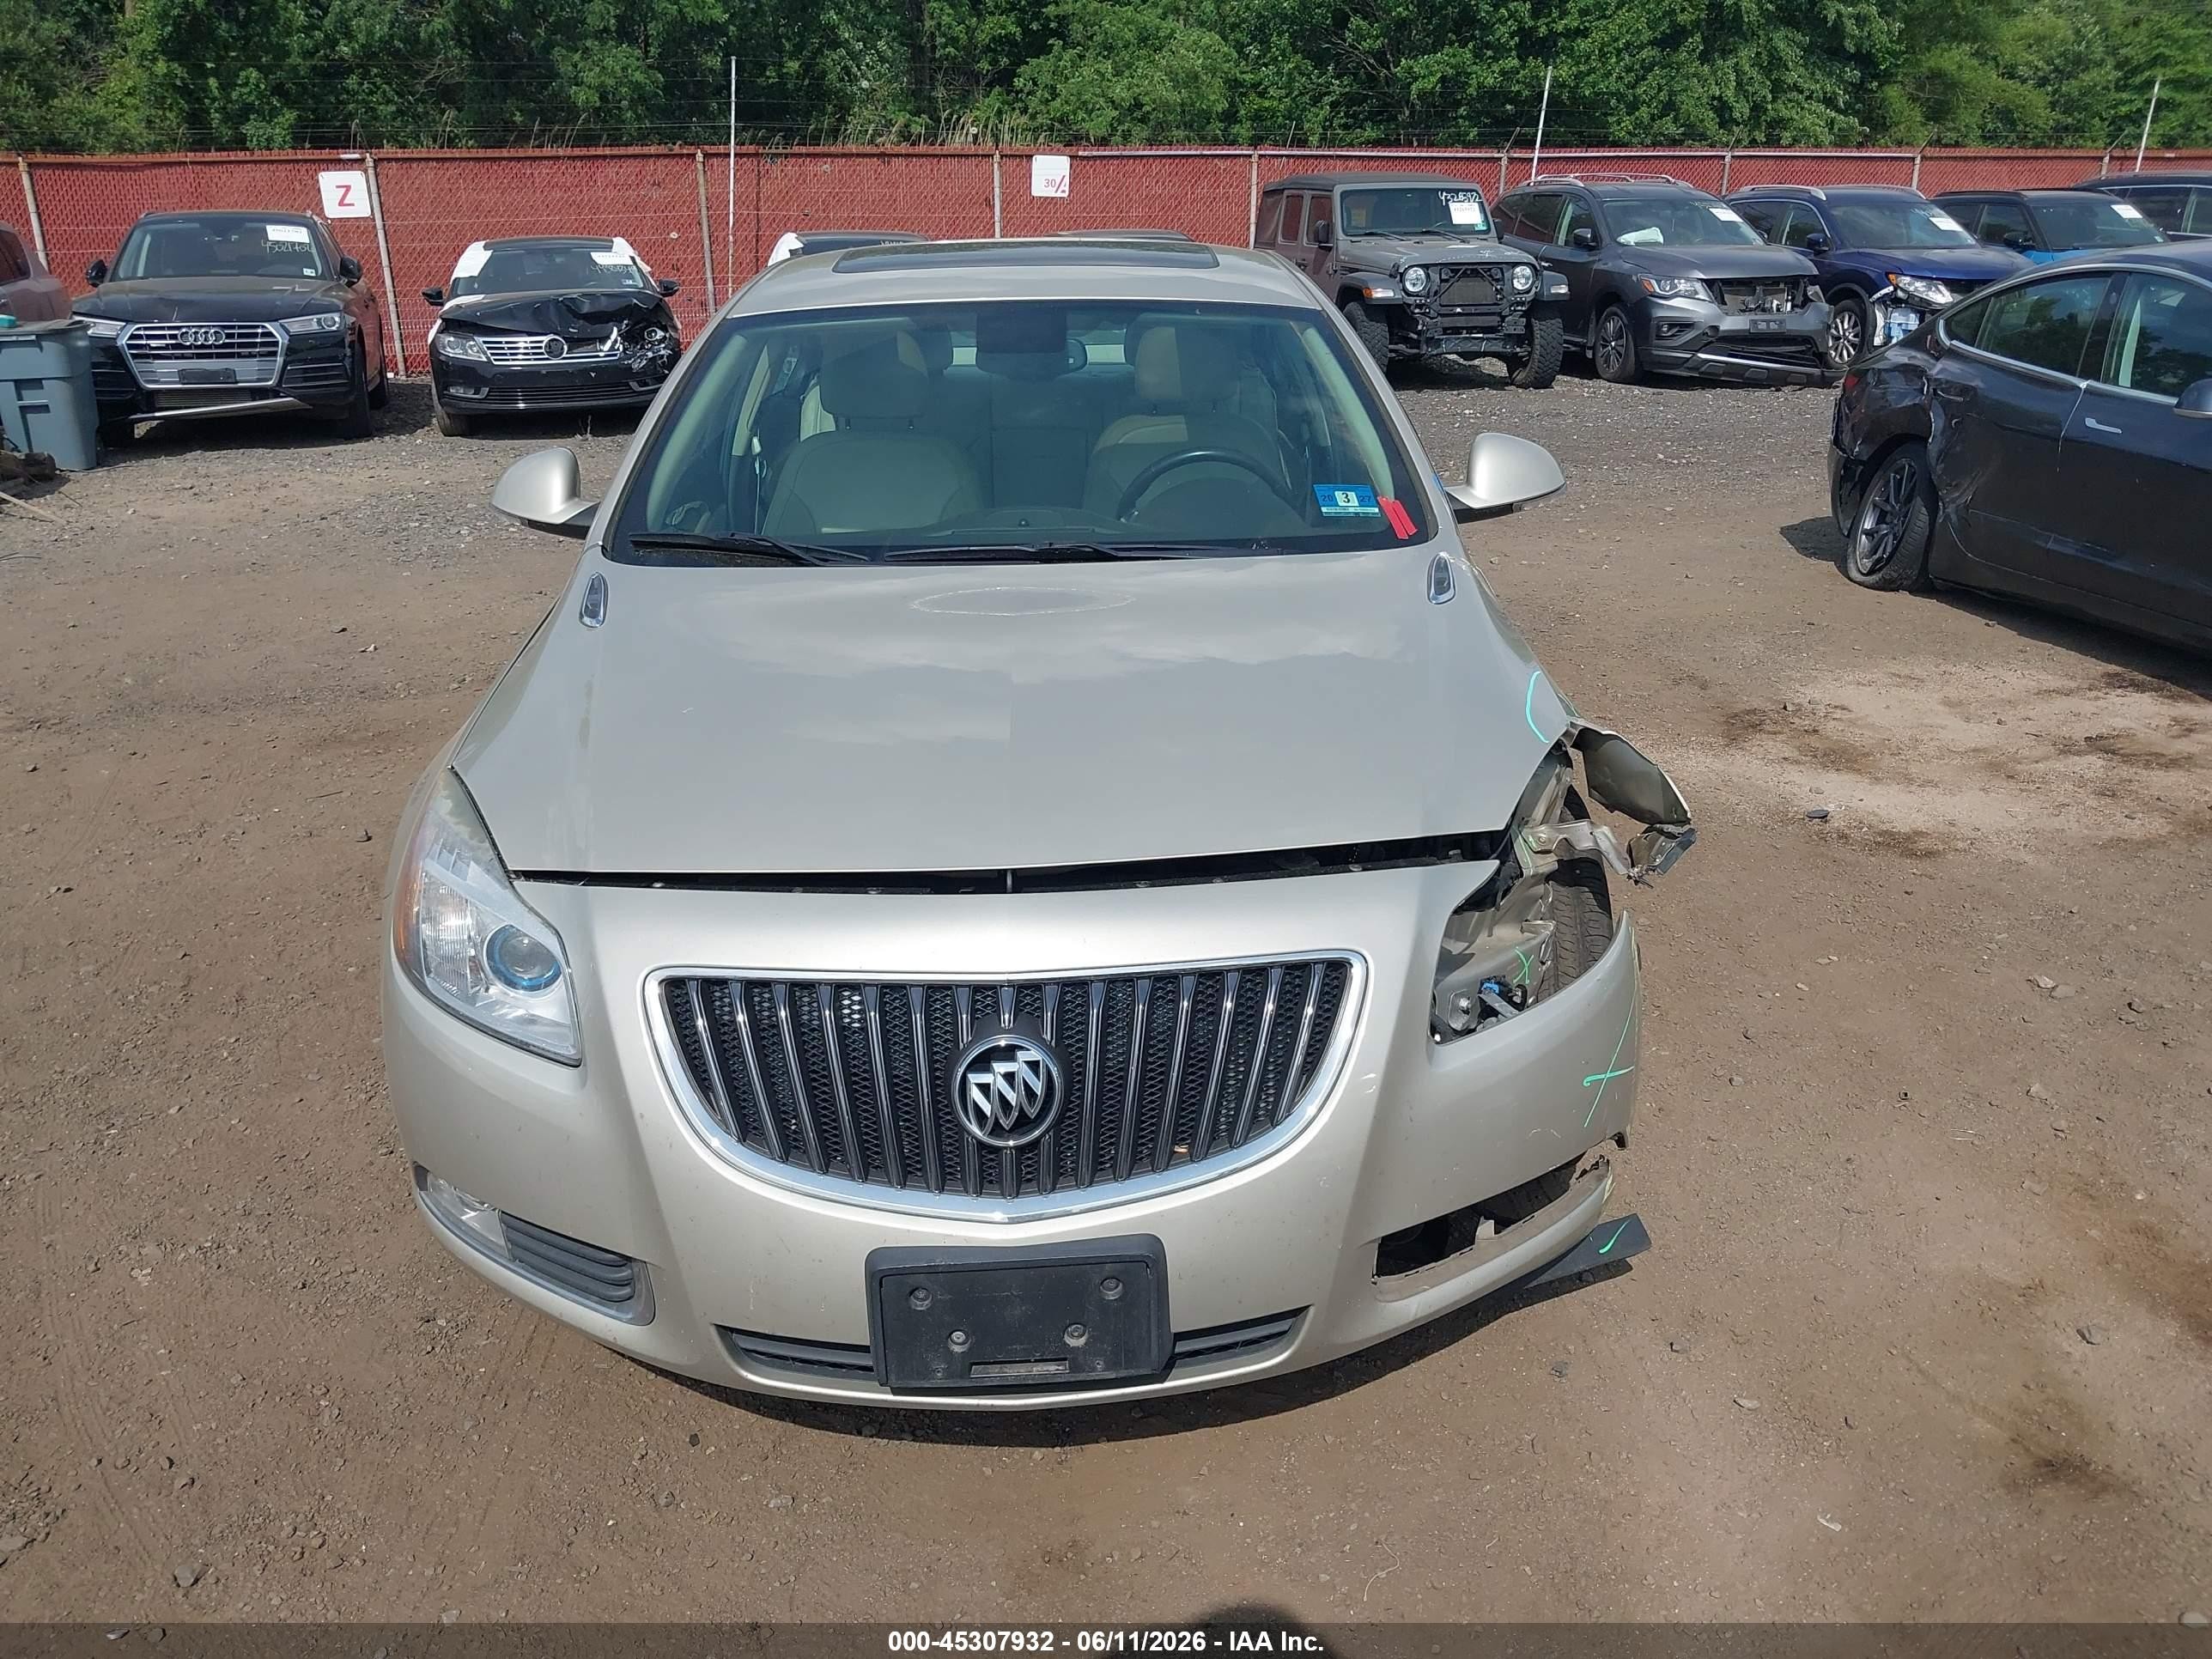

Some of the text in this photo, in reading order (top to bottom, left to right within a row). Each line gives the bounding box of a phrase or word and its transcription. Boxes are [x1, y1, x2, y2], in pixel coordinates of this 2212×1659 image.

[335, 185, 356, 207] Z
[1321, 492, 1371, 503] 20 3 27
